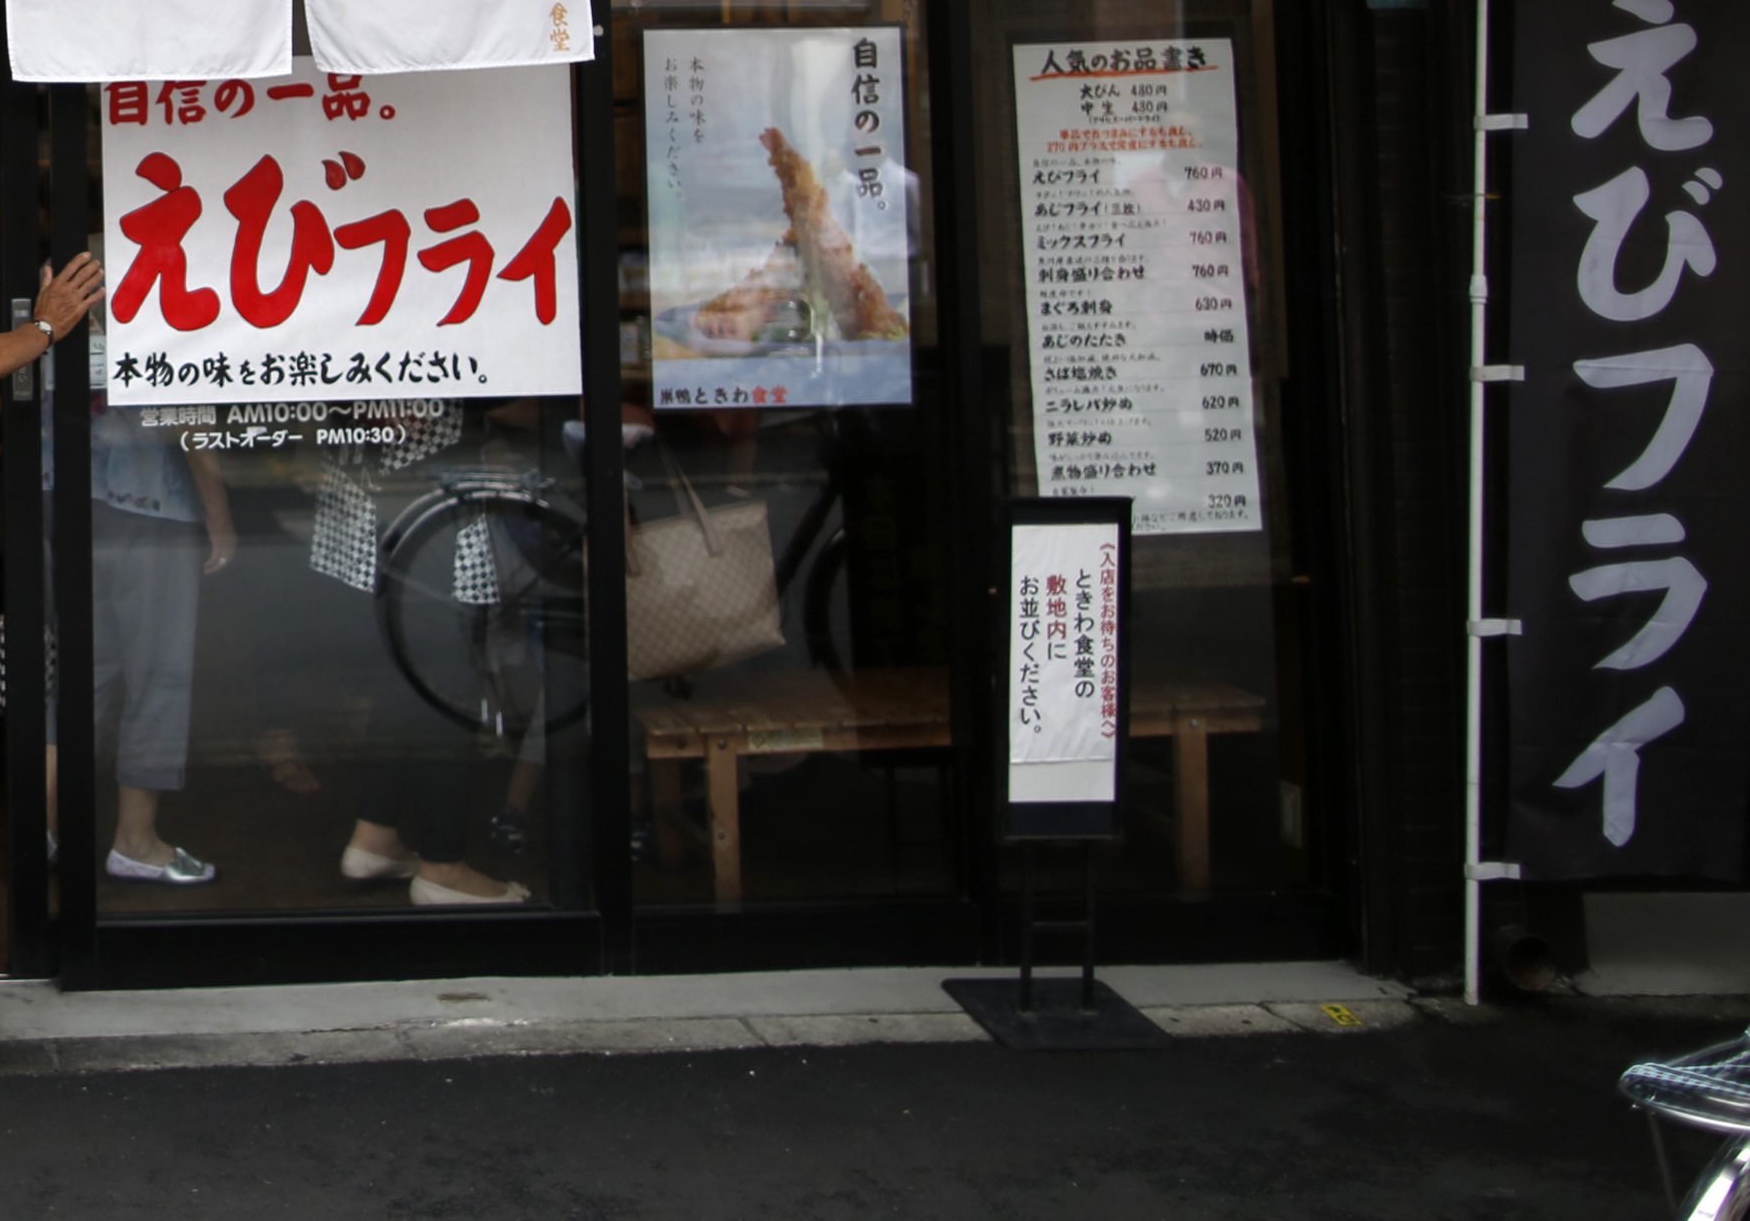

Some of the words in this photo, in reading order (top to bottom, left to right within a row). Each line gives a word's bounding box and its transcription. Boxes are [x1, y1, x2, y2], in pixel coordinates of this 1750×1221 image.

[1041, 46, 1206, 73] 人気のお品書き
[104, 73, 396, 125] 自信の一品。
[852, 37, 889, 211] 自信の一品。
[111, 151, 572, 332] えびフライ
[112, 351, 488, 386] 本物の味をお楽しみください。
[1042, 333, 1126, 349] あじのたたき
[140, 408, 216, 427] 営業時間
[1046, 574, 1067, 659] 敷地内に
[1074, 569, 1095, 698] ときわ食堂の
[1019, 576, 1041, 733] お並びください。
